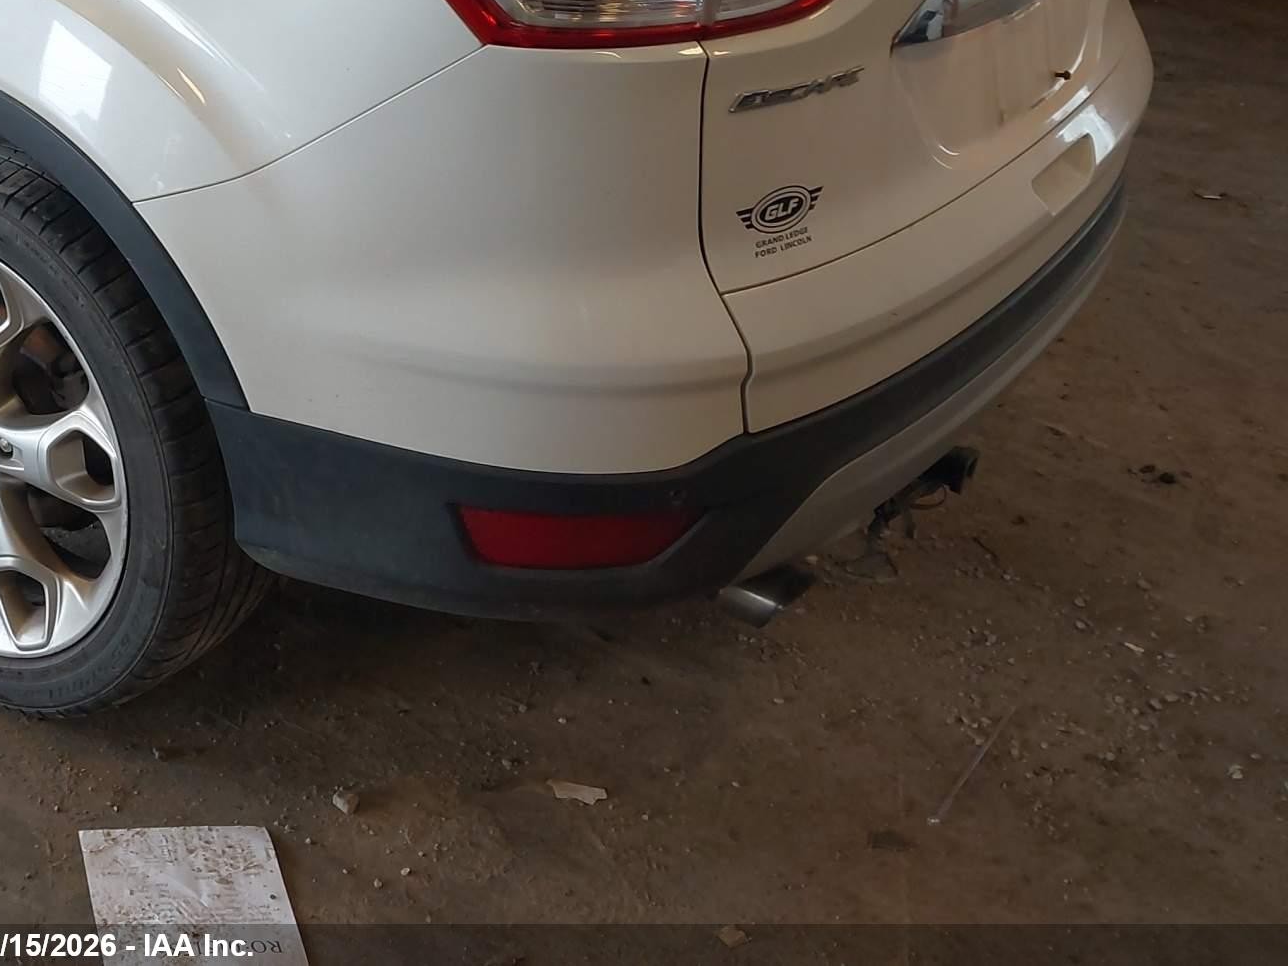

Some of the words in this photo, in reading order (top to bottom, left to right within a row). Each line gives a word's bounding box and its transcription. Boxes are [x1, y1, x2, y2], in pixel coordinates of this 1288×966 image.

[764, 197, 801, 221] GLF
[755, 235, 785, 249] GRAND
[785, 226, 808, 240] LEDGE
[755, 247, 777, 258] FORD
[780, 236, 813, 251] LINCOLN
